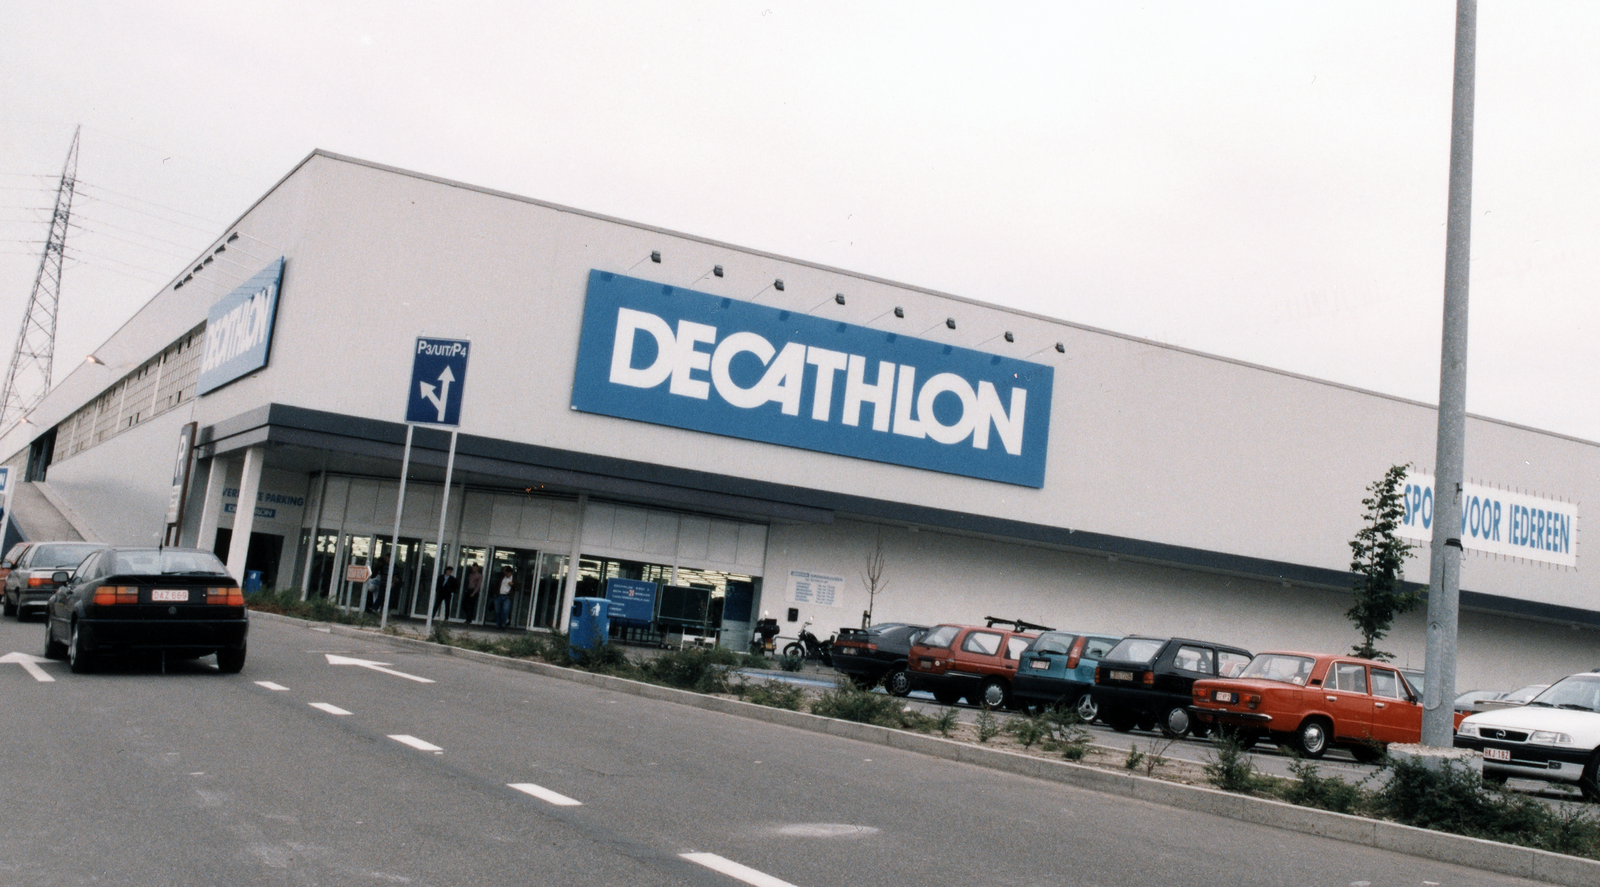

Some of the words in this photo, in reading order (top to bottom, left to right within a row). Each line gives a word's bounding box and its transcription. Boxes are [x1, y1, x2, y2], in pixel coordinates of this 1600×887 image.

[417, 340, 467, 358] P3/UIT/P4
[608, 306, 1027, 457] DECATHLON
[265, 493, 304, 507] PARKING
[1403, 483, 1433, 530] SPO
[1508, 503, 1570, 554] IEDEREEN
